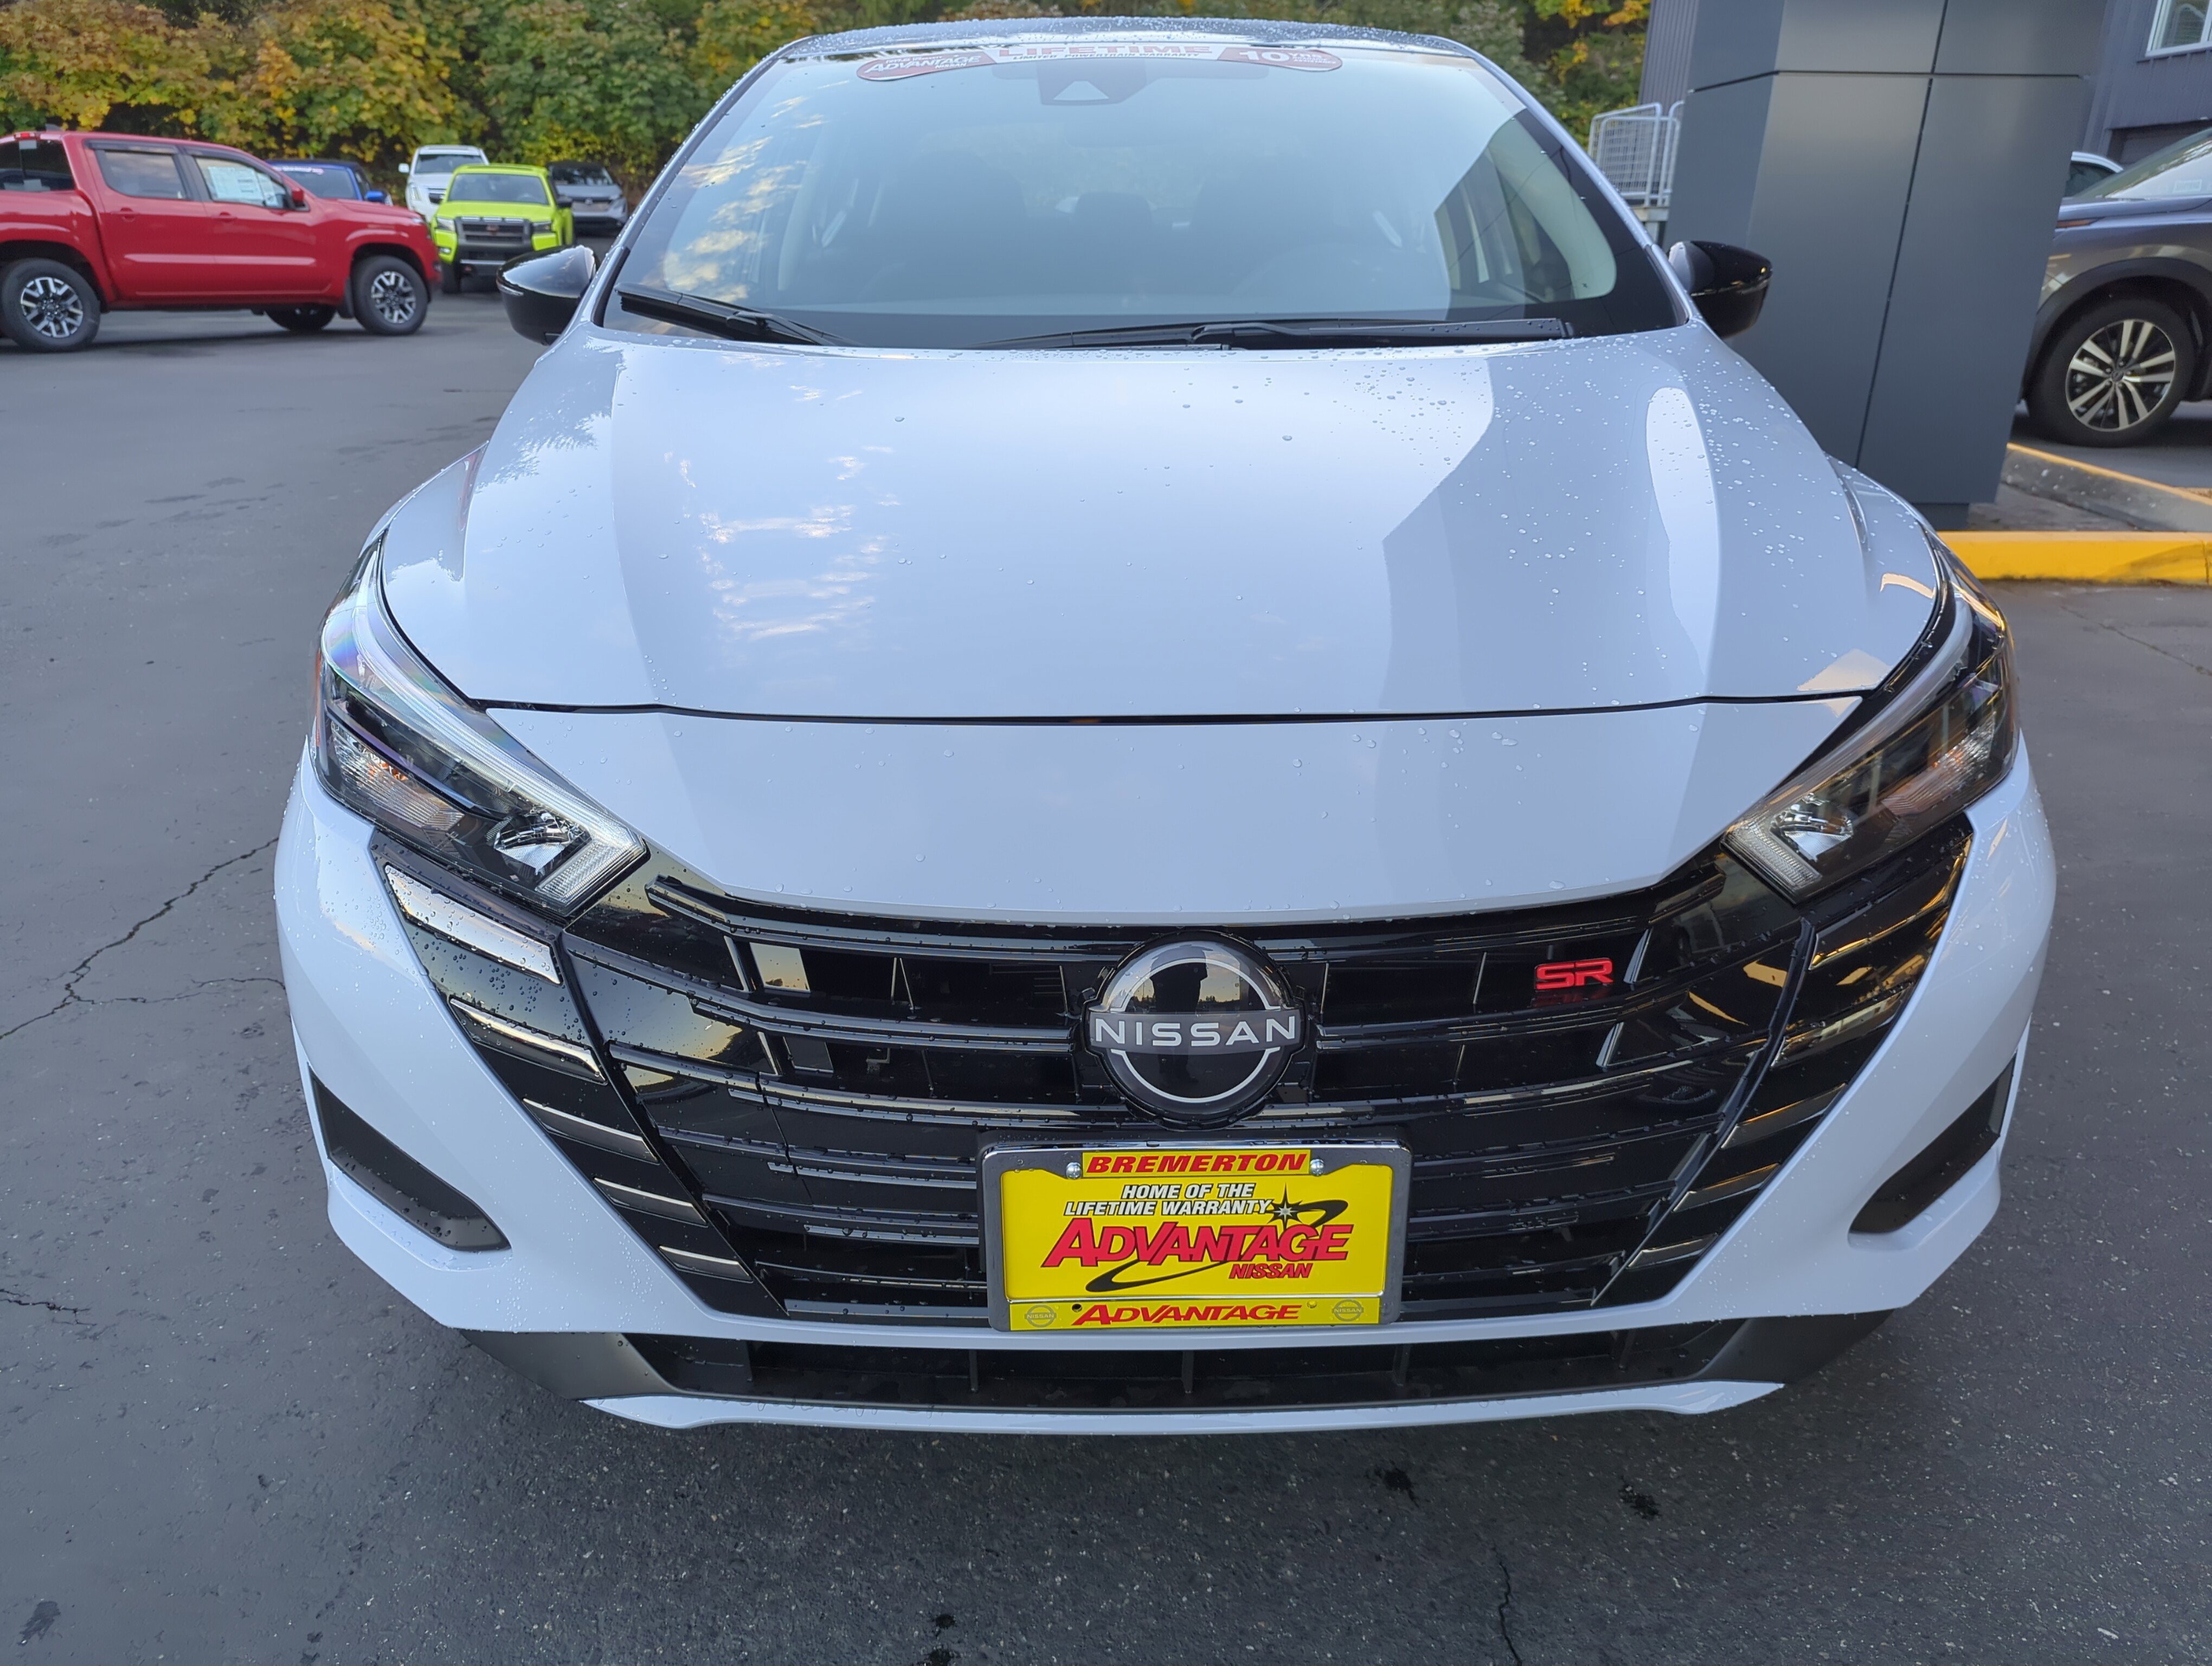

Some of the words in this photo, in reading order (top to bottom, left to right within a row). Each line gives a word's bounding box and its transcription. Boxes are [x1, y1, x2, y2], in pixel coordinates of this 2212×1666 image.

[999, 46, 1212, 56] LIFETIME
[1239, 50, 1290, 62] 10
[864, 55, 981, 73] ADVANTAGE
[1535, 957, 1613, 990] SR
[1095, 1016, 1295, 1047] NISSAN
[1086, 1153, 1308, 1174] BREMERTON
[1121, 1184, 1182, 1199] HOME
[1184, 1183, 1213, 1199] OF
[1217, 1182, 1256, 1198] THE
[1063, 1201, 1161, 1216] LIFETIME
[1161, 1199, 1274, 1215] WARRANTY
[1040, 1218, 1354, 1267] ADVANTAGE
[1229, 1263, 1314, 1279] NISSAN
[1071, 1304, 1302, 1325] ADVANTAGE
